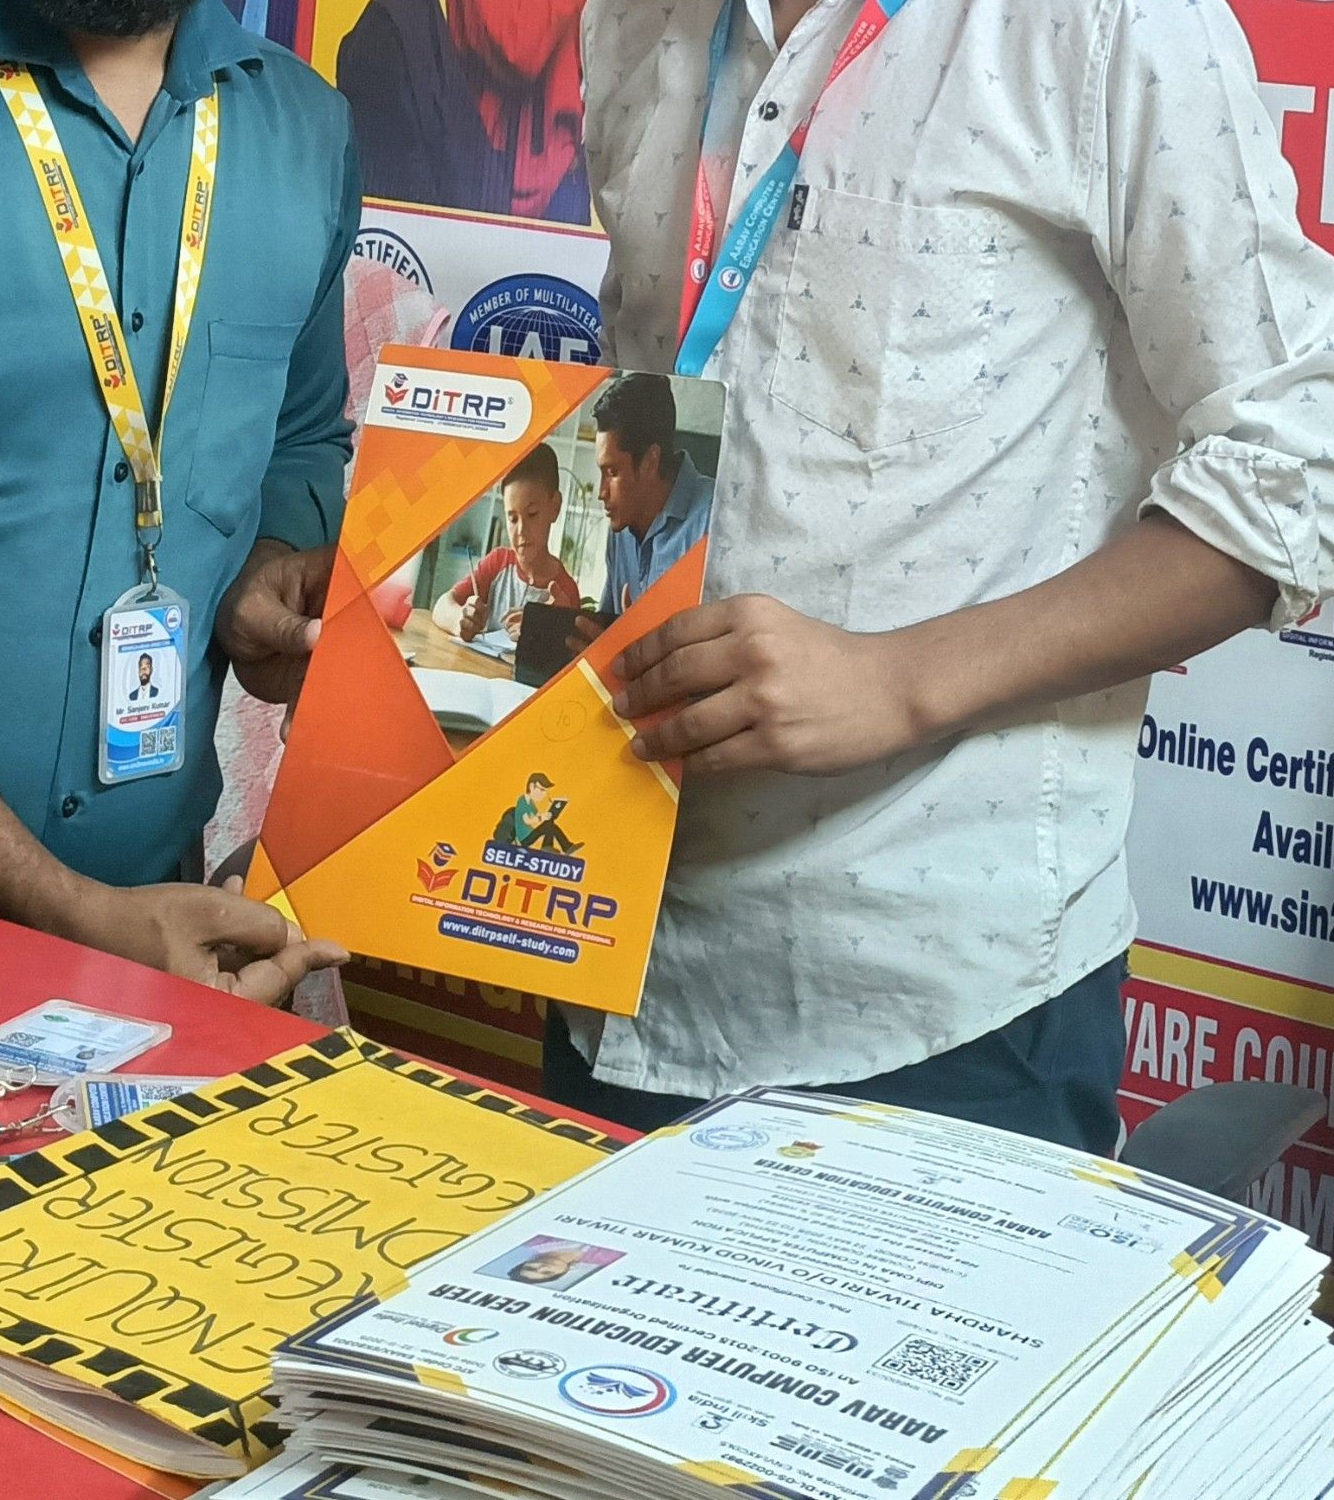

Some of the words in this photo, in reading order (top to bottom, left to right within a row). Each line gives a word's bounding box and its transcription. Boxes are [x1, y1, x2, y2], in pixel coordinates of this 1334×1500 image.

[730, 228, 750, 261] AARAV
[745, 180, 776, 227] COMPUTER
[739, 218, 768, 269] EDUCATION
[762, 181, 785, 220] CENTER
[469, 292, 511, 325] MEMBER
[517, 288, 530, 301] OF
[534, 288, 603, 336] MULTILATERA
[1138, 713, 1237, 777] Online
[485, 847, 582, 880] SELF-STUDY
[462, 868, 618, 928] DiTRP
[435, 901, 474, 915] INFORMATION
[475, 908, 514, 924] TECHNOLOGY
[521, 918, 553, 932] RESEARCH
[442, 919, 576, 959] www.ditrpself-study.com
[249, 1099, 549, 1212] EGISTER
[754, 1158, 812, 1177] CENTER
[816, 1171, 901, 1199] EDUCATION
[127, 1134, 468, 1268] DMISSION
[905, 1192, 992, 1223] COMPUTER
[553, 1213, 627, 1241] TIWARI
[692, 1219, 798, 1248] APPLICATION
[995, 1217, 1051, 1239] AARAV
[1090, 1229, 1137, 1246] ISO
[632, 1229, 711, 1257] KUMAR
[715, 1247, 786, 1272] VINOD
[790, 1266, 830, 1287] D/O
[879, 1267, 945, 1291] DIPLOMA
[428, 1283, 531, 1316] CENTER
[553, 1292, 646, 1321] Organization
[840, 1280, 921, 1311] TIWARI
[612, 1275, 859, 1354] Certificate
[648, 1317, 718, 1341] Certified
[931, 1307, 1044, 1349] SHARDHA
[528, 1304, 683, 1357] EDUCATION
[721, 1337, 803, 1368] 9001:2015
[681, 1347, 840, 1406] COMPUTER
[808, 1365, 833, 1380] ISO
[837, 1373, 860, 1386] An
[687, 1394, 729, 1415] India
[731, 1409, 768, 1428] Skill
[840, 1400, 947, 1444] AARAV
